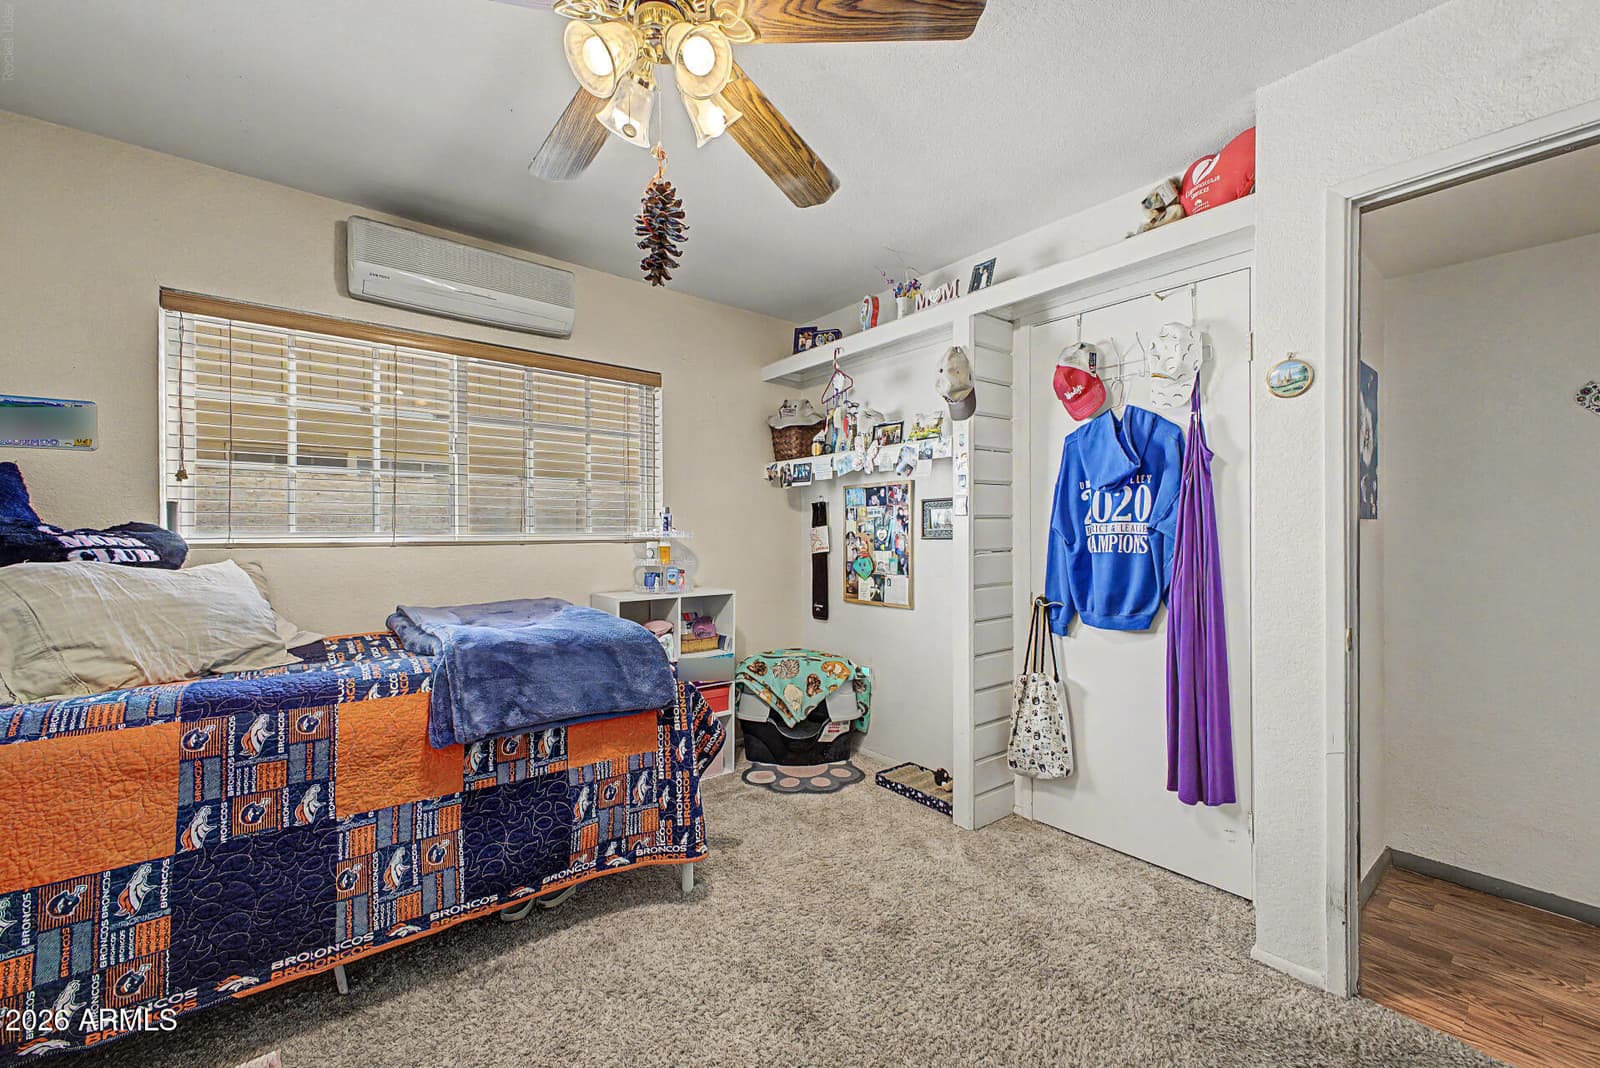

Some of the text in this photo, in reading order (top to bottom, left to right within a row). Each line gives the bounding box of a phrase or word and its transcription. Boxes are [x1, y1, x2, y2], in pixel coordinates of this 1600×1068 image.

[1081, 485, 1152, 525] 2020
[1087, 535, 1148, 554] CAMPIONS
[278, 711, 286, 753] BRONCOS
[683, 770, 691, 826] BRONCOS
[636, 845, 687, 856] BRONCOS
[160, 858, 170, 909] BRONCOS
[542, 860, 597, 884] BRONCOS
[21, 892, 32, 946] BRONCOS
[100, 870, 111, 968] BRONCOS BRONCOS
[429, 894, 499, 921] BRONCOS
[60, 927, 71, 978] BRONCOS
